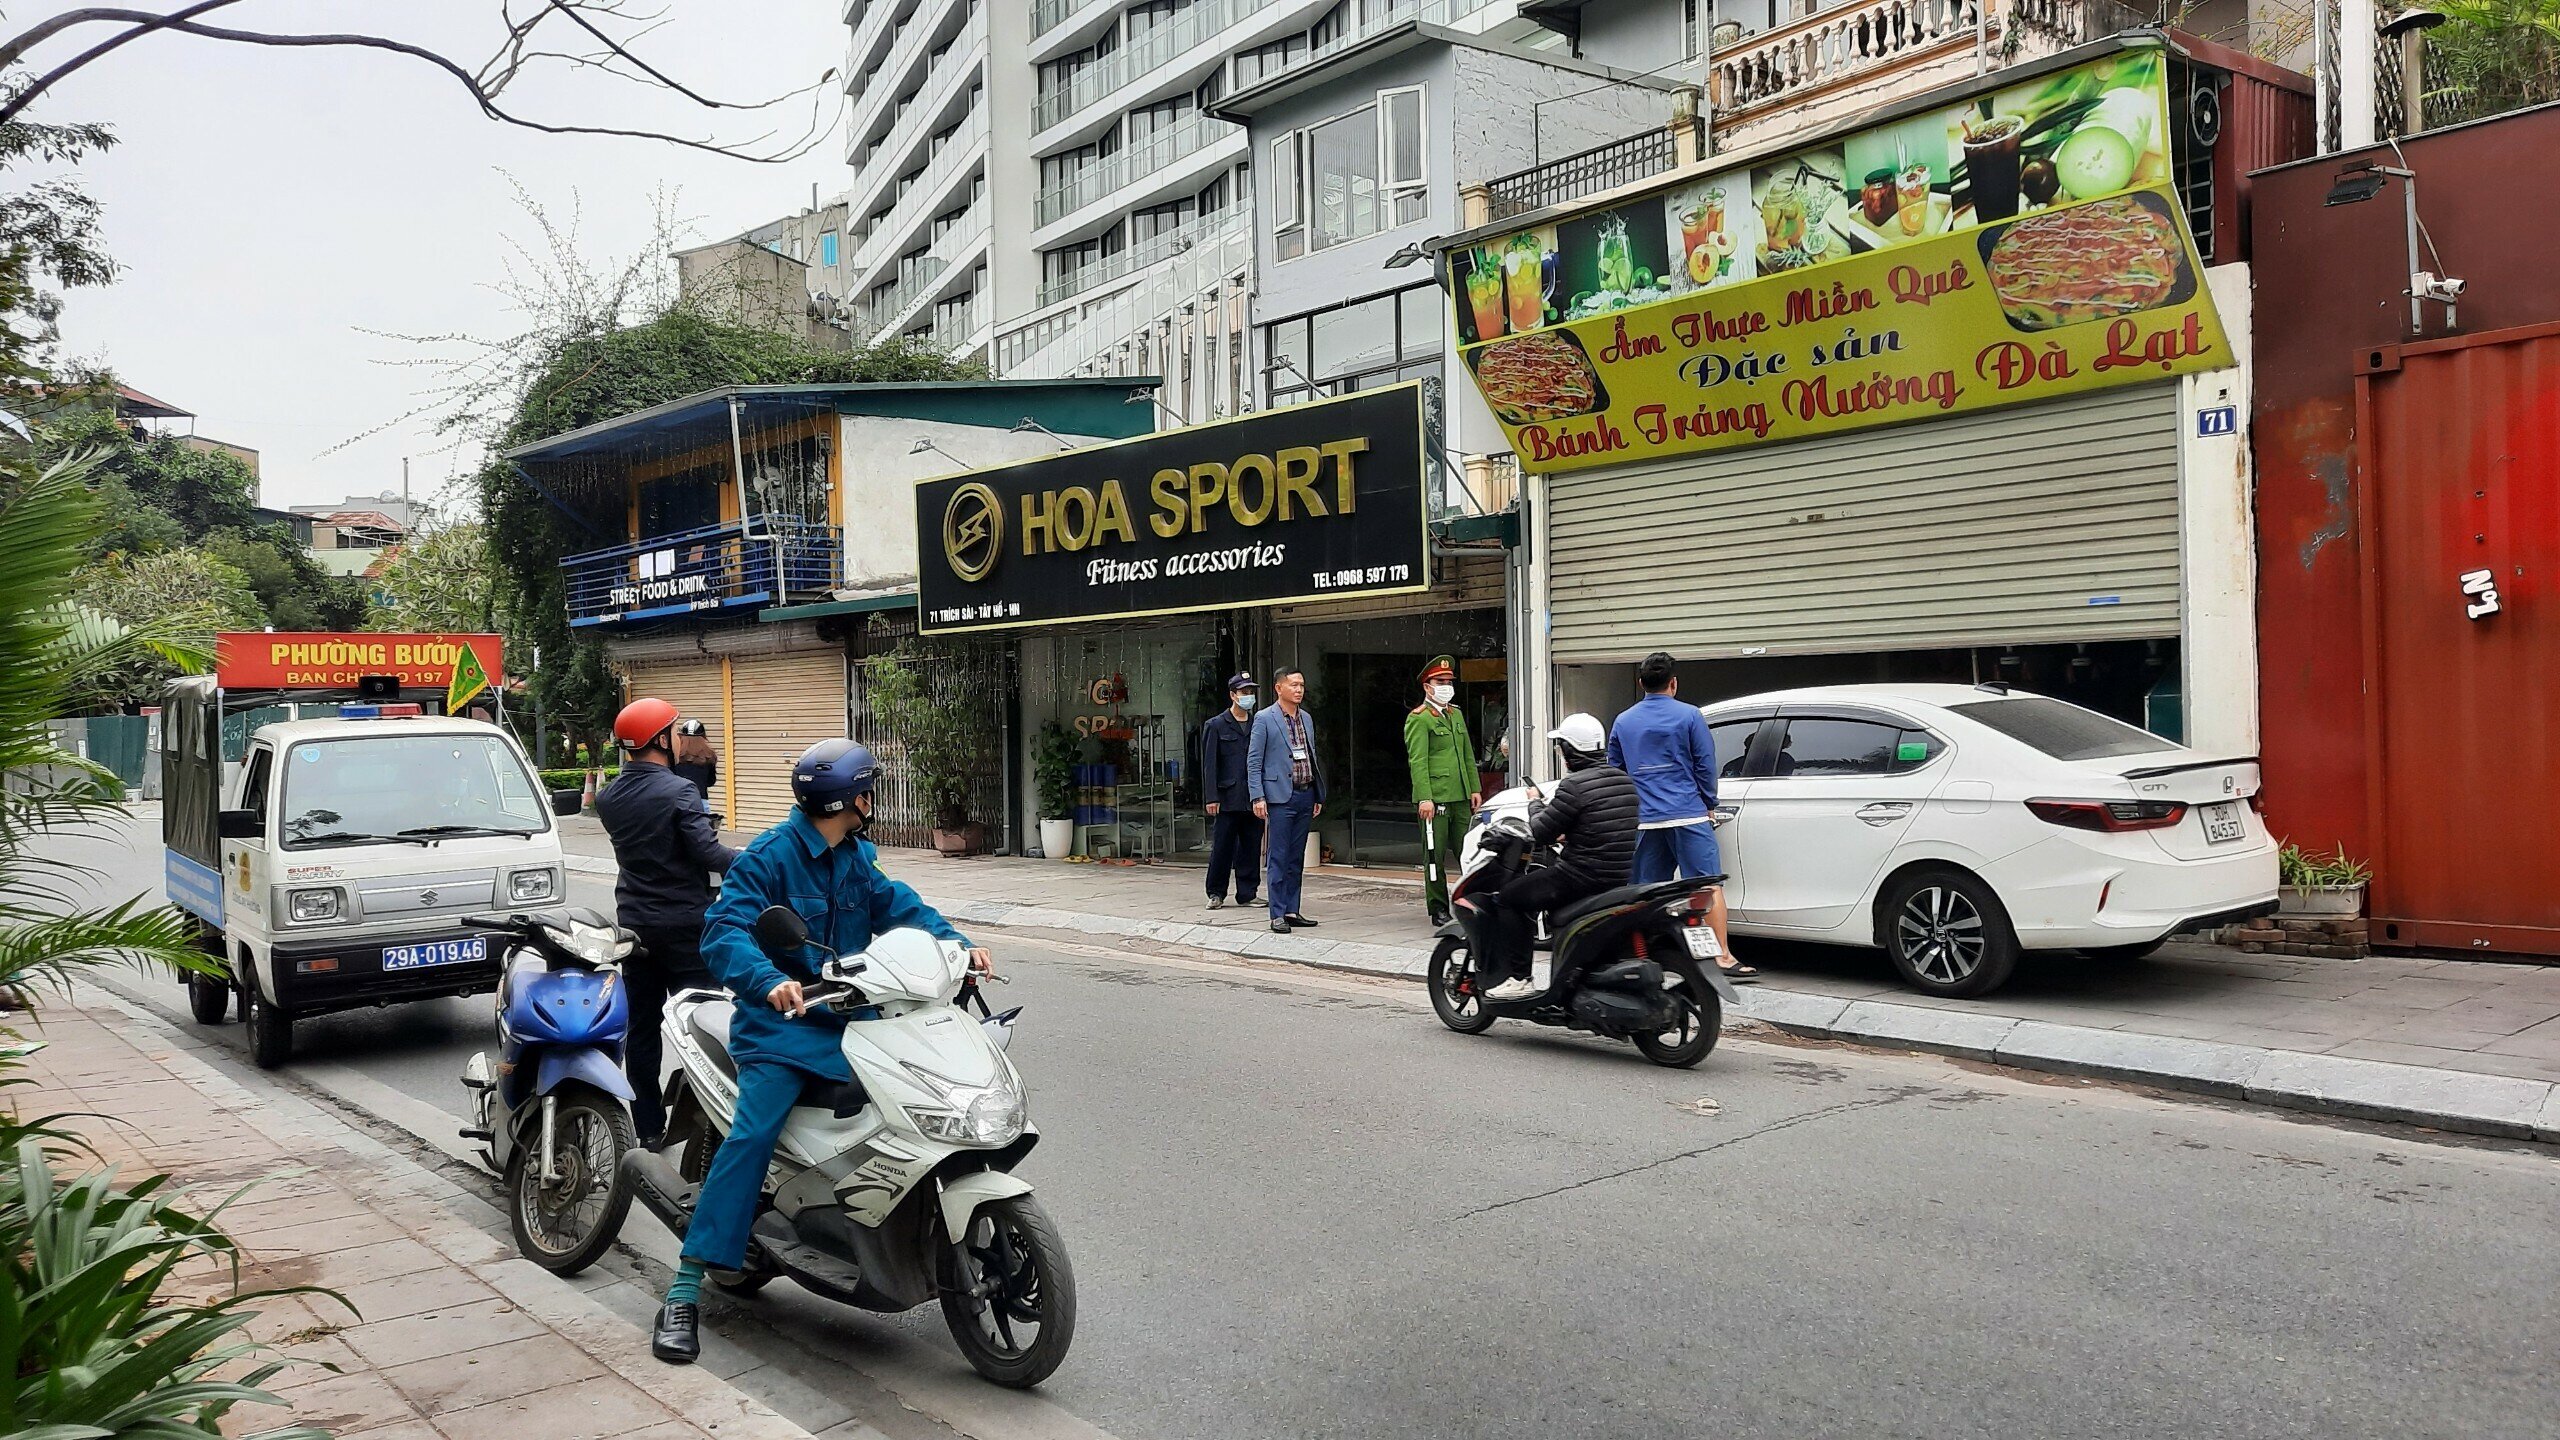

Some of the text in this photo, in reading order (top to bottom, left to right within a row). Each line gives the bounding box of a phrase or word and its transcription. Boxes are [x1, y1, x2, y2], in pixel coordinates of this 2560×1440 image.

[1778, 283, 1880, 327] Miền
[1887, 259, 1975, 307] Quê
[1678, 327, 1909, 388] Đặc sản
[1518, 312, 2212, 462] Bánh Tráng Nướng Đà Lạt
[2204, 412, 2229, 432] 71
[1020, 436, 1370, 556] HOA SPORT
[1086, 540, 1286, 586] Fitness accessories
[1365, 567, 1387, 583] 597
[1389, 564, 1409, 581] 179
[610, 575, 705, 606] STREET FOOD & DRINK
[929, 610, 938, 623] 71
[940, 606, 960, 622] TRÍCH
[961, 603, 974, 620] SÀI
[1008, 602, 1020, 616] HN
[271, 638, 386, 666] PHƯỜNG
[286, 672, 327, 684] BAN
[415, 672, 443, 683] 197
[2142, 783, 2169, 792] CITY
[287, 866, 332, 874] SUPER
[287, 869, 345, 880] CARRY
[386, 941, 483, 968] 29A-019.46
[873, 1160, 908, 1178] HONDA
